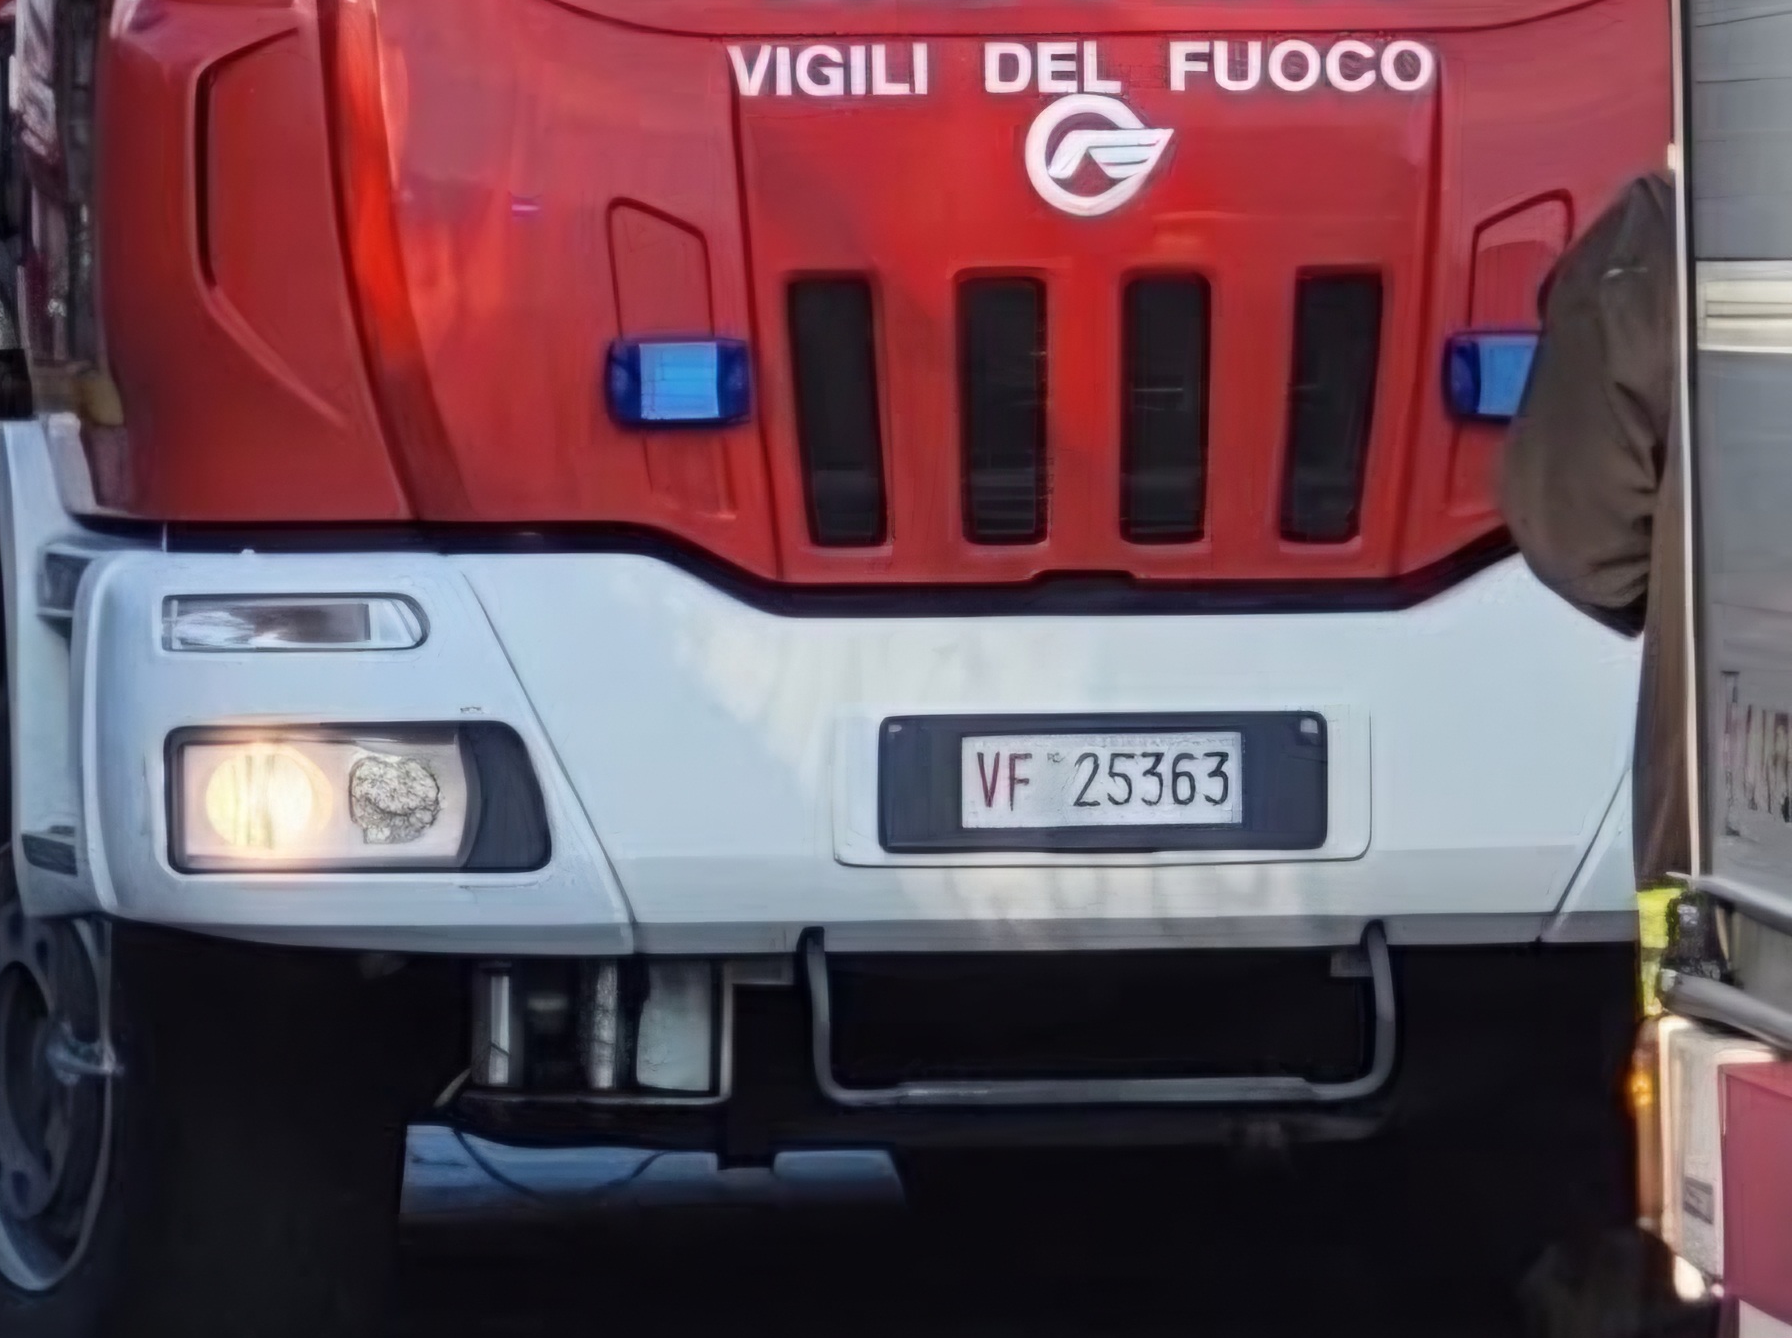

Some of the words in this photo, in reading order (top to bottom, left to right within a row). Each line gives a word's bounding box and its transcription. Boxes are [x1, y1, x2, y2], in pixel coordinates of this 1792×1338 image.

[726, 41, 929, 97] VIGILI
[983, 40, 1122, 94] DEL
[1169, 38, 1434, 93] FUOCO
[976, 751, 1033, 811] VF
[1073, 751, 1230, 808] 25363
